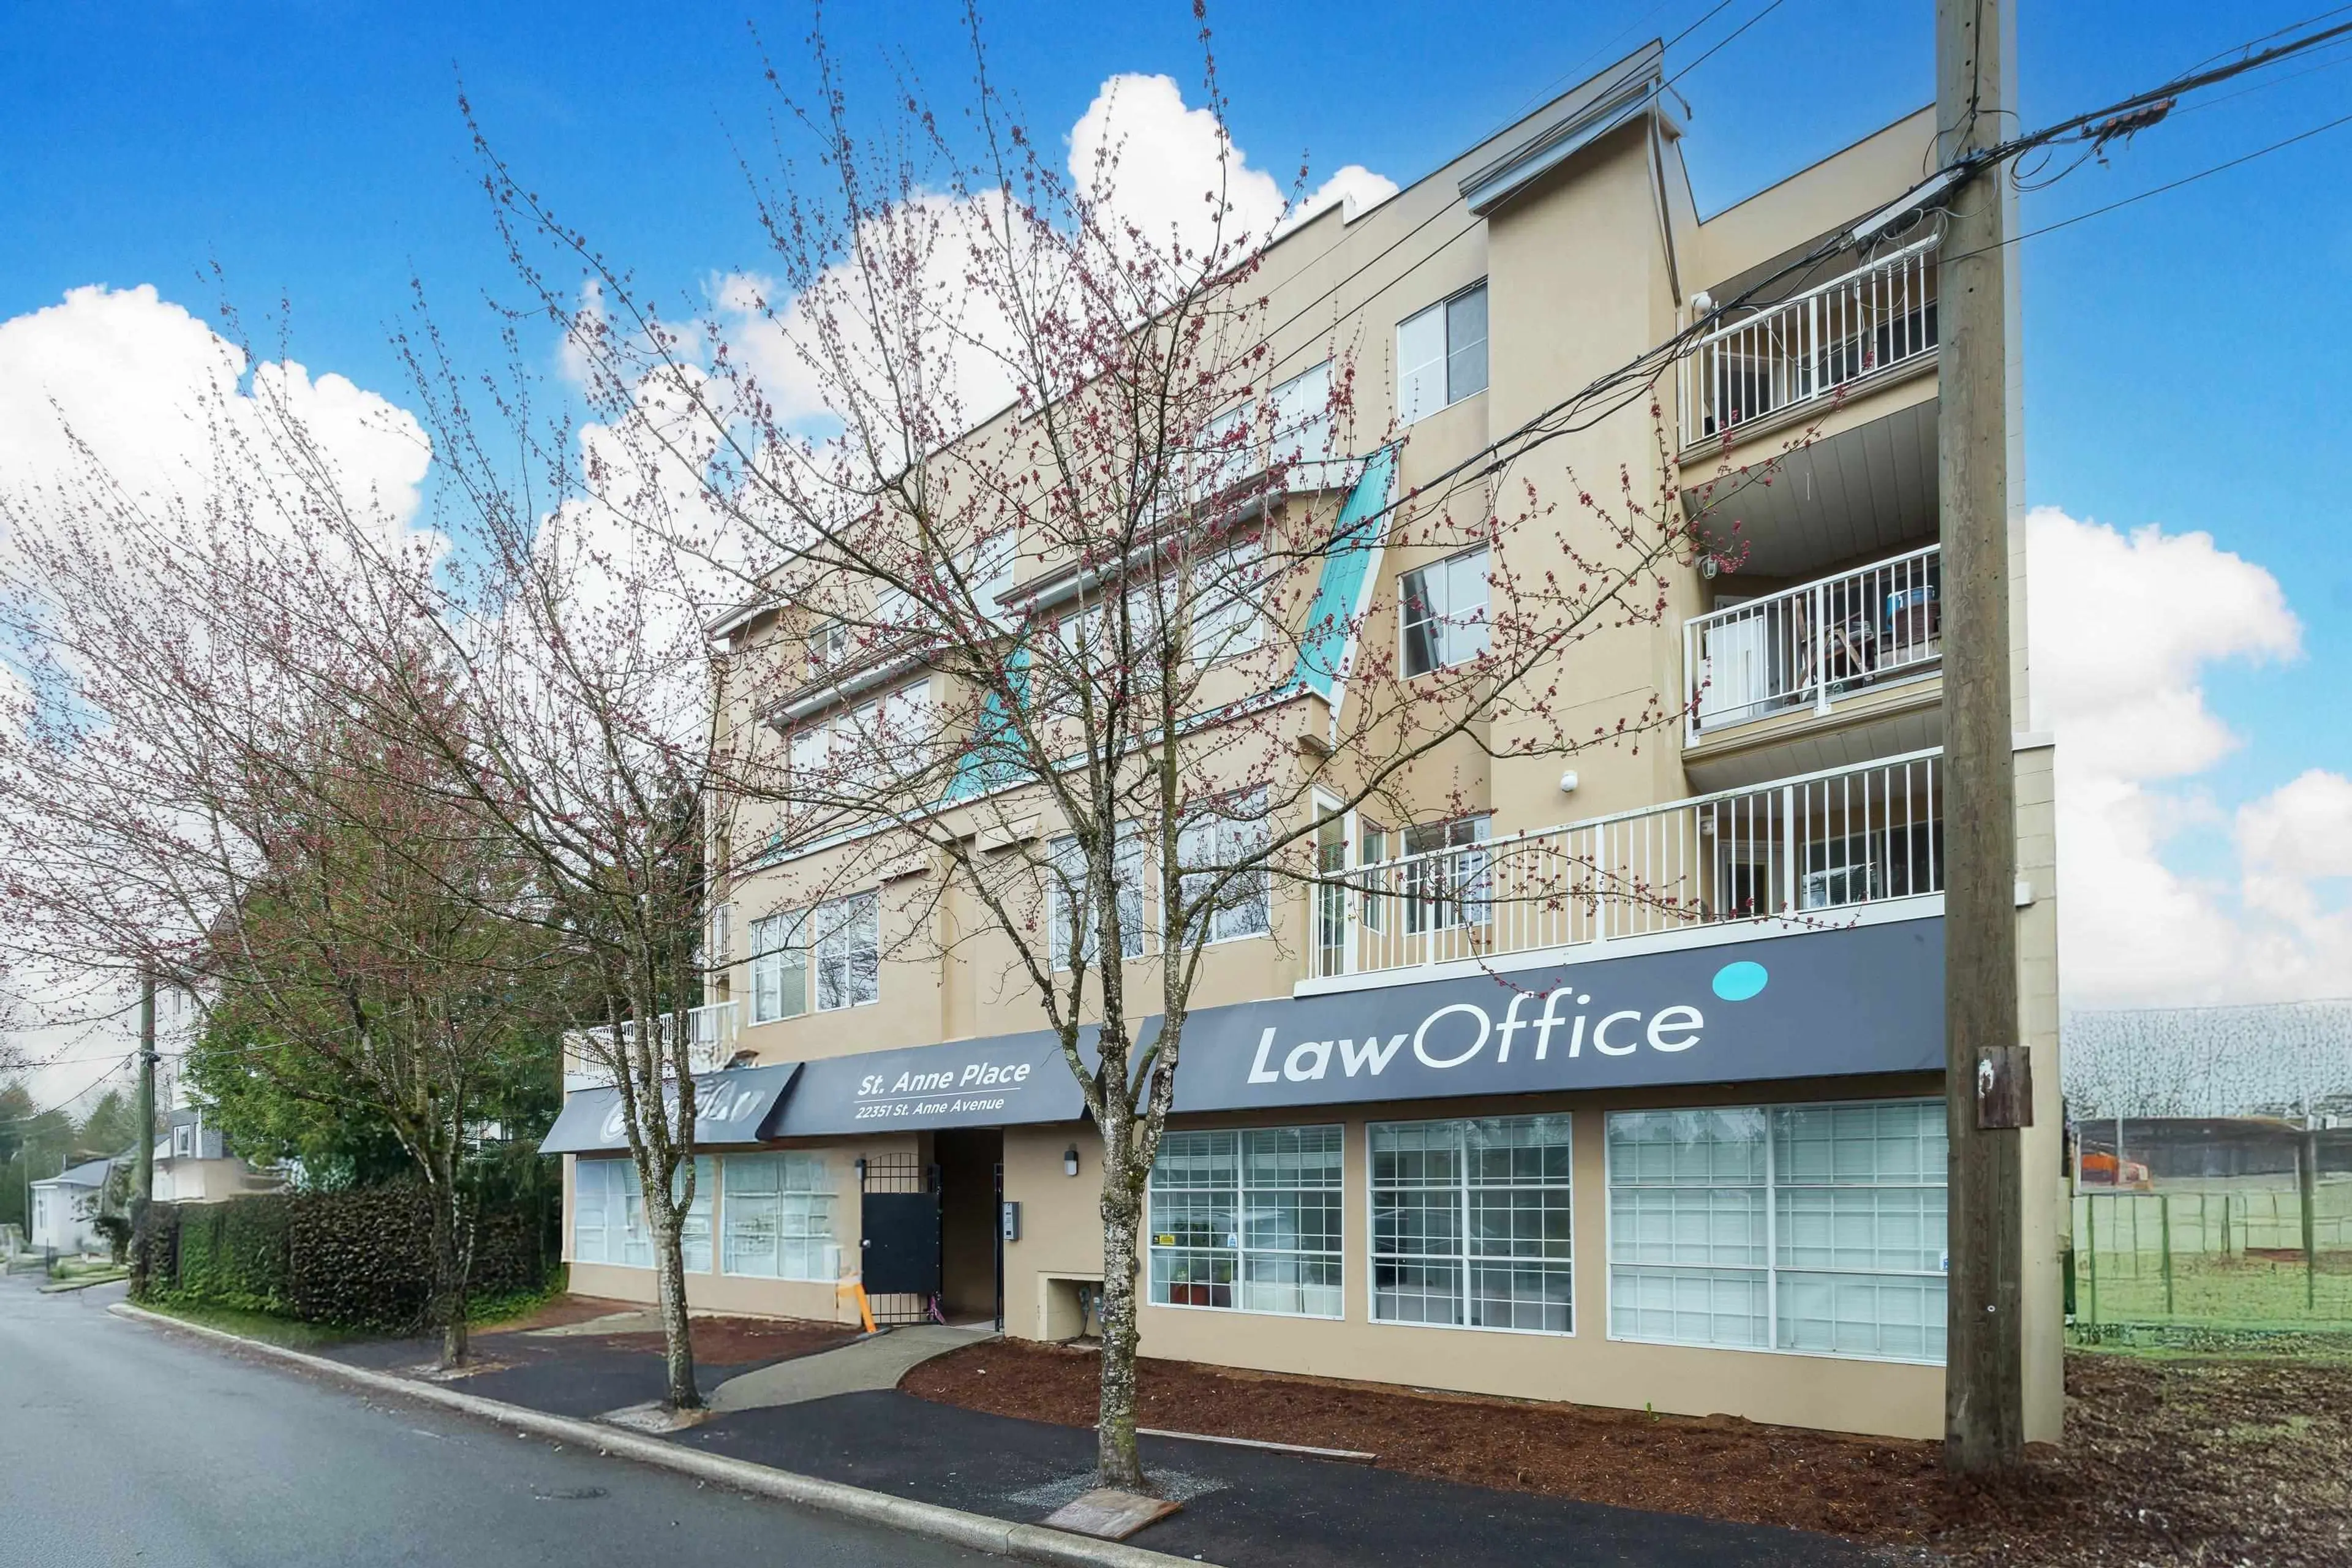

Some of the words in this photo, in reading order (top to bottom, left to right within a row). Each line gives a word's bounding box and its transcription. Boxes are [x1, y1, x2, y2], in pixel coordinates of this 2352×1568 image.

[857, 1074, 885, 1096] St.
[891, 1071, 954, 1093] Anne
[959, 1062, 1031, 1087] Place
[855, 1105, 893, 1119] 22351
[893, 1104, 909, 1116] St.
[913, 1102, 948, 1115] Anne
[950, 1098, 1005, 1113] Avenue
